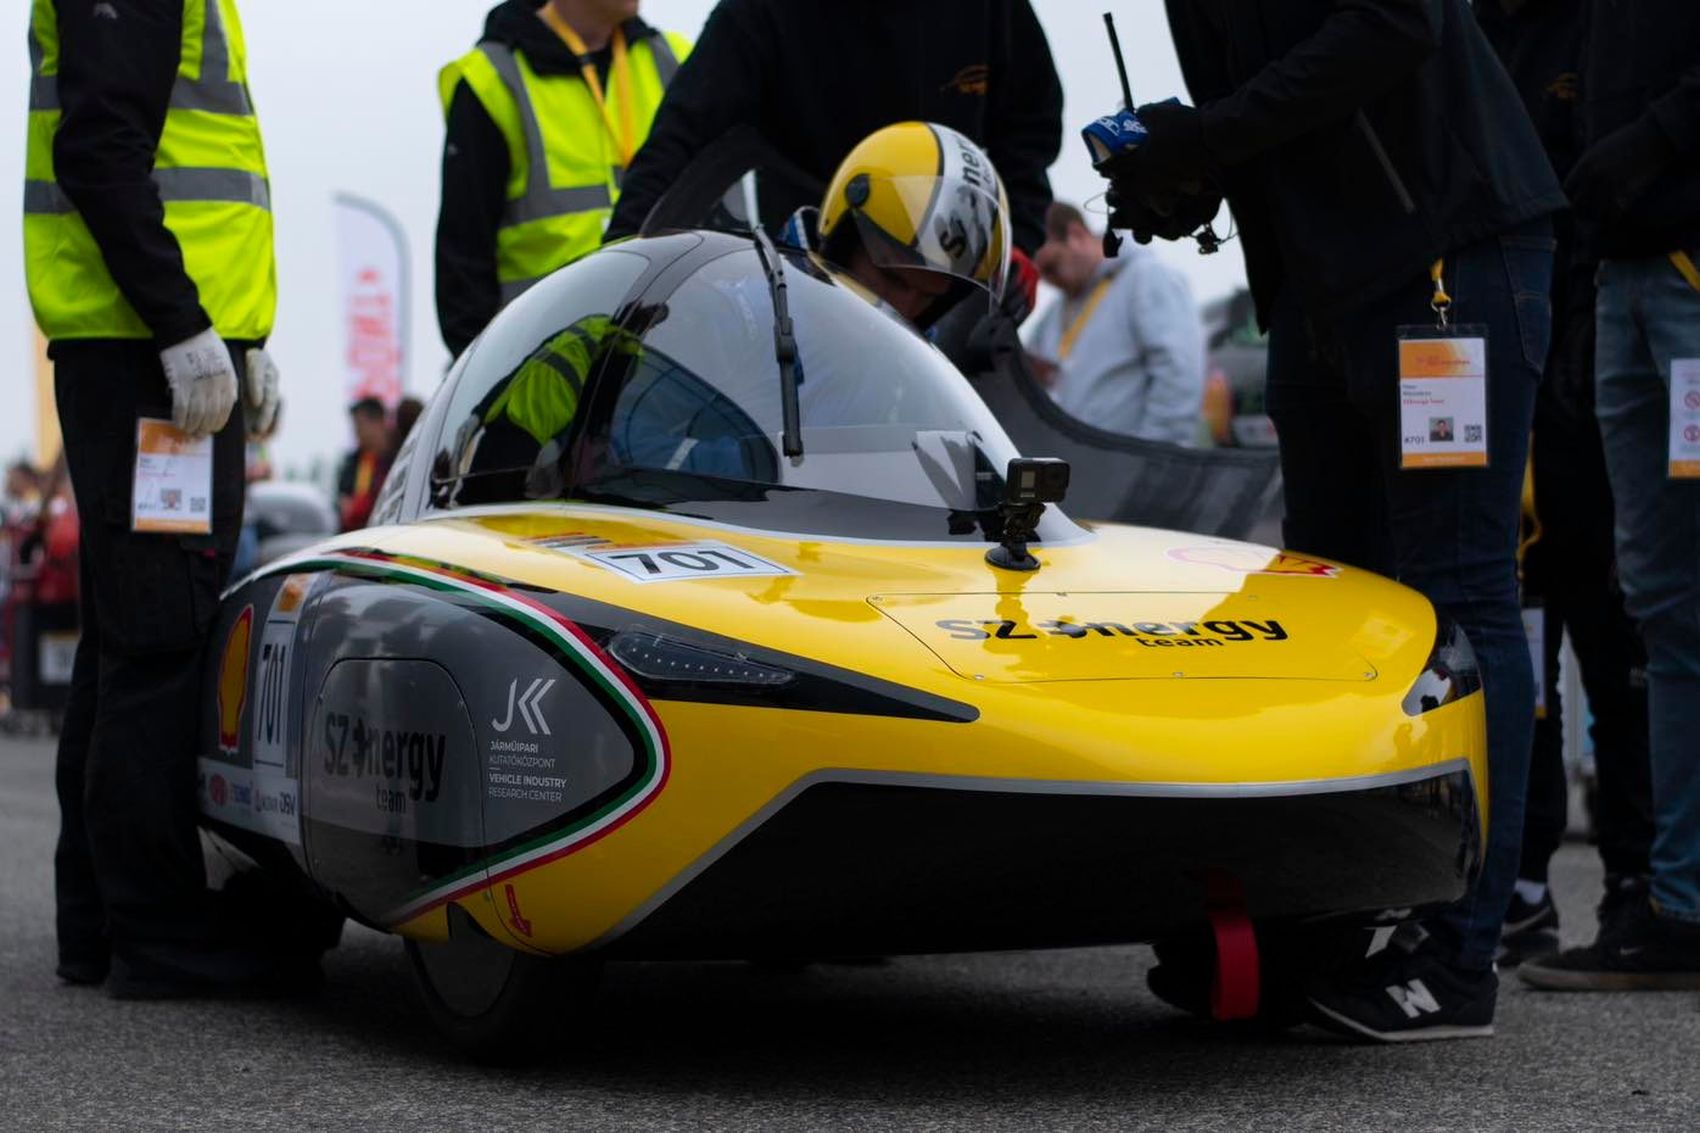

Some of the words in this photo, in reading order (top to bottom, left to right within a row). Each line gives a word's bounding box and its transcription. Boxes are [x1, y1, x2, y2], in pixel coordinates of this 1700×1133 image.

[609, 550, 755, 575] 701
[1135, 637, 1225, 648] team
[257, 643, 286, 744] 701
[489, 773, 522, 785] VEHICLE
[523, 775, 567, 788] INDUSTRY
[375, 783, 407, 814] team
[488, 787, 528, 799] RESEARCH
[529, 790, 562, 802] CENTER
